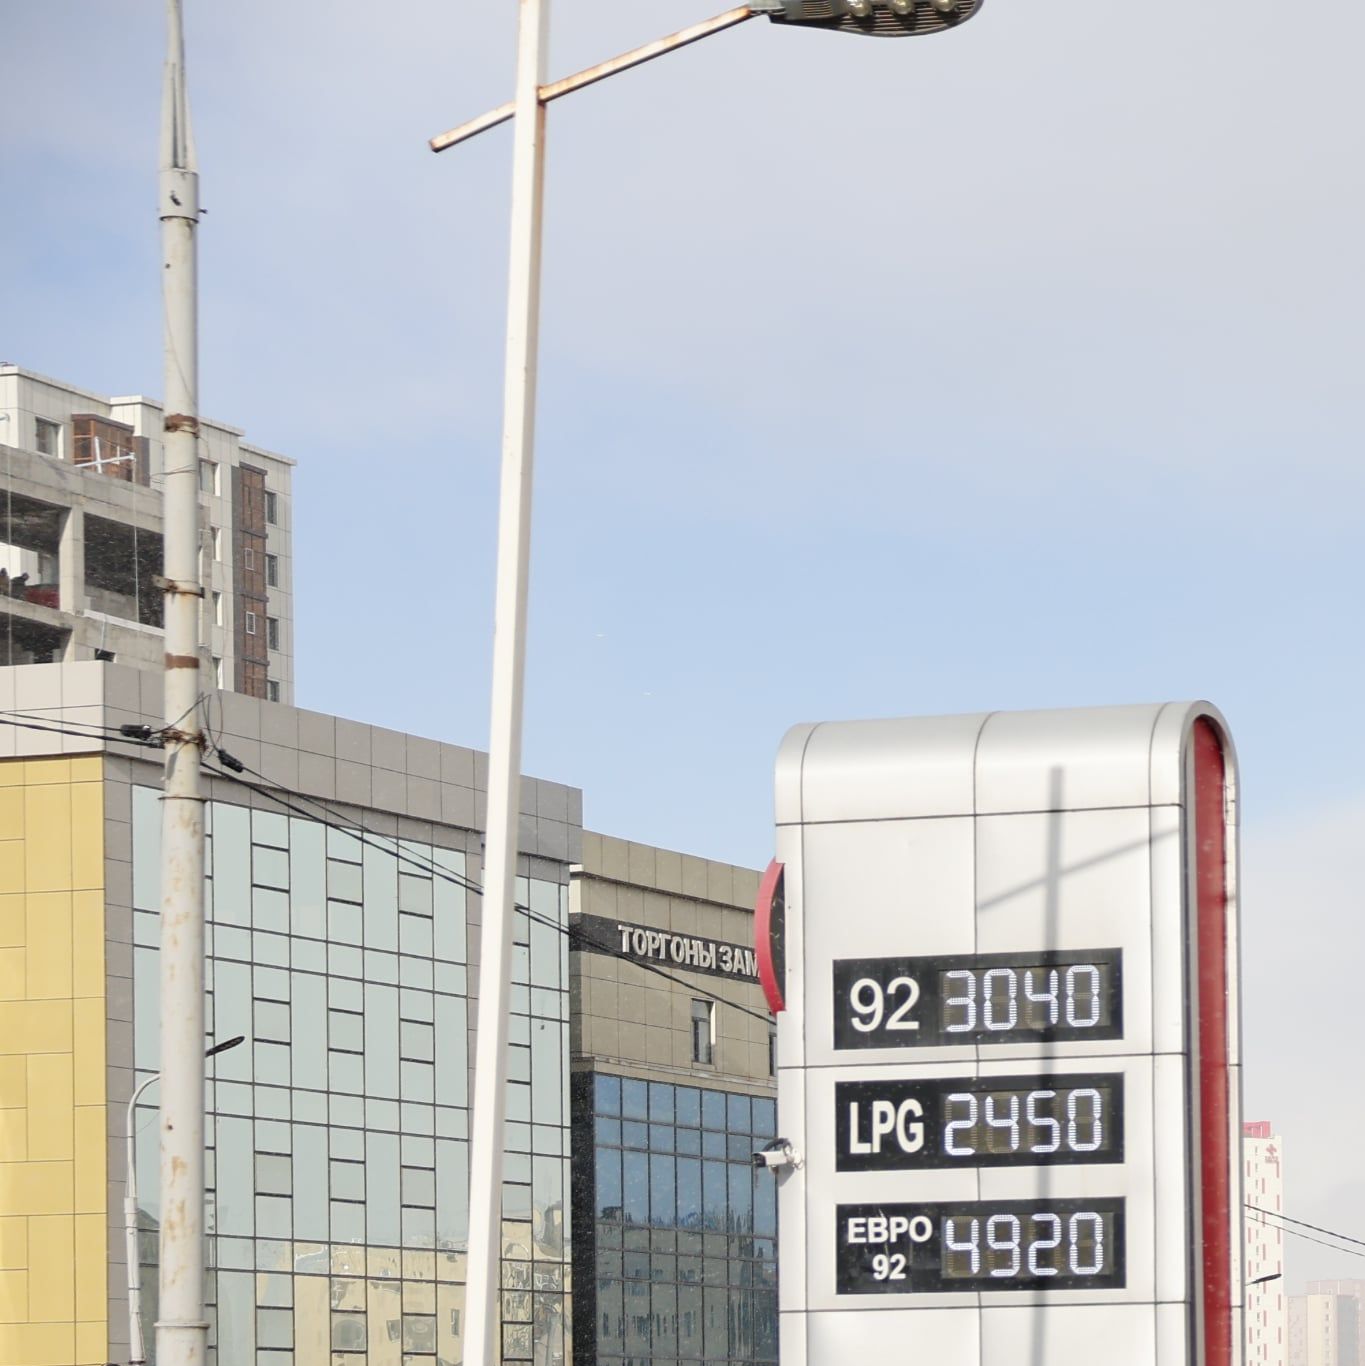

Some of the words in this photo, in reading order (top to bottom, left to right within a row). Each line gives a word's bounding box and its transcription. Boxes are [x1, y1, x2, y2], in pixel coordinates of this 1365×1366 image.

[617, 924, 717, 970] ТОРГОНЫ
[849, 976, 921, 1032] 92
[945, 964, 1101, 1033] 3040
[848, 1098, 925, 1155] LPG
[944, 1088, 1103, 1157] 2450
[847, 1215, 933, 1244] ЕВРО
[946, 1212, 1104, 1277] 4920
[871, 1254, 907, 1281] 92
